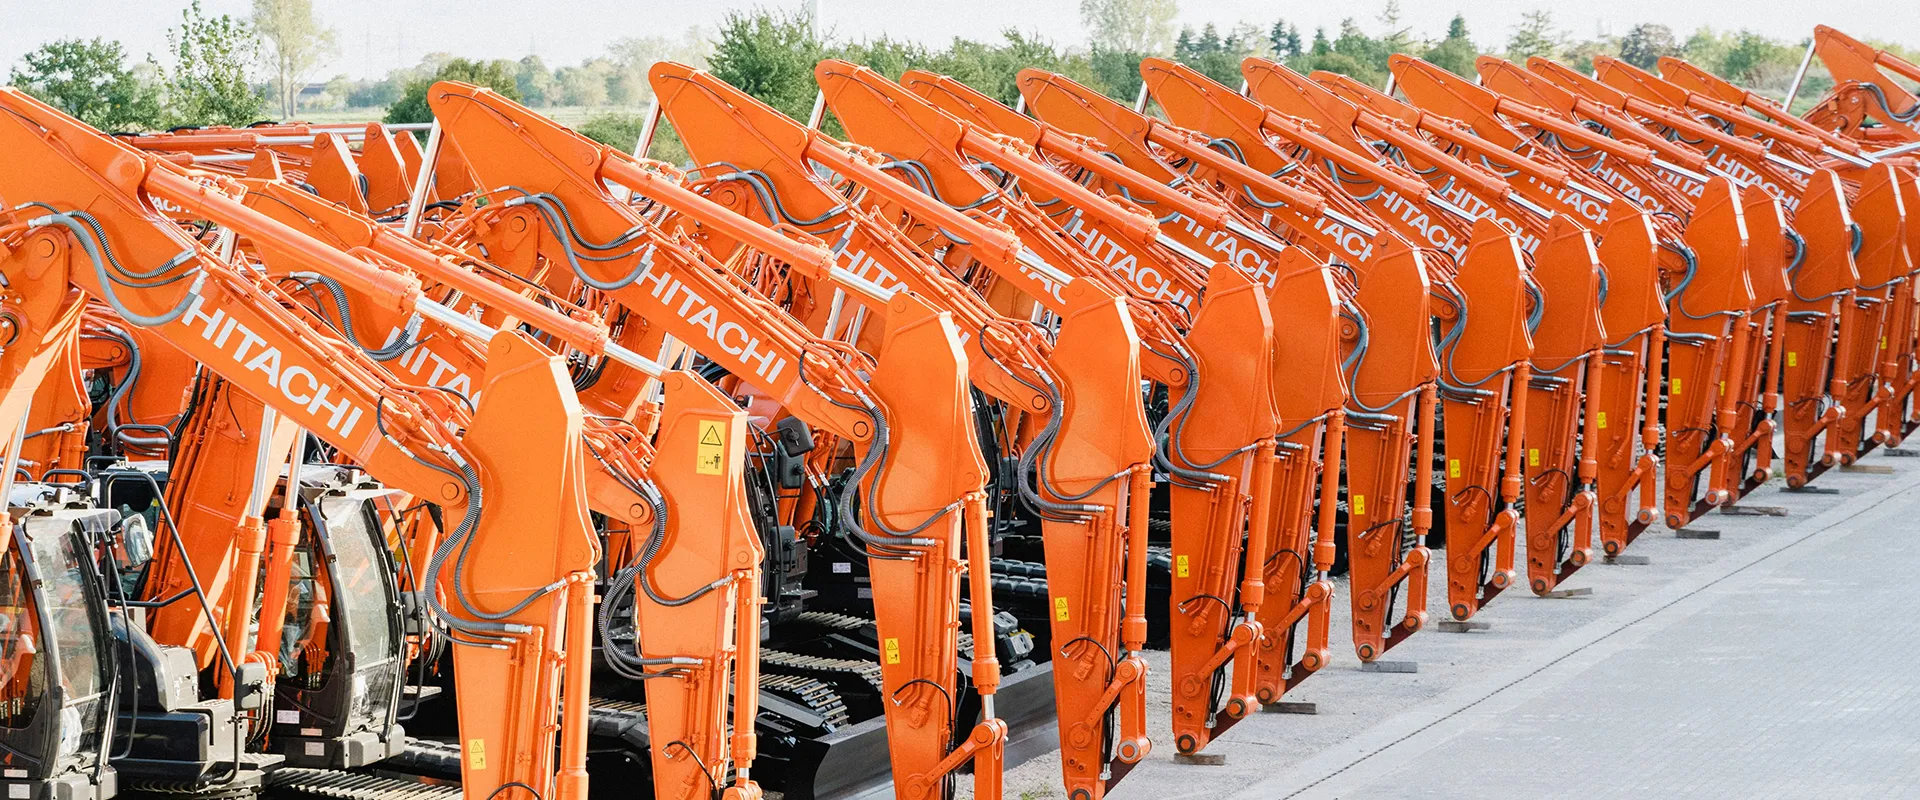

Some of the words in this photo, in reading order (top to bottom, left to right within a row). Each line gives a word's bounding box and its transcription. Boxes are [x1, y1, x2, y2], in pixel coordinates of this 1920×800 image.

[634, 259, 787, 385] HITACHI
[1070, 218, 1193, 314] HITACHI
[181, 294, 364, 440] HITACHI
